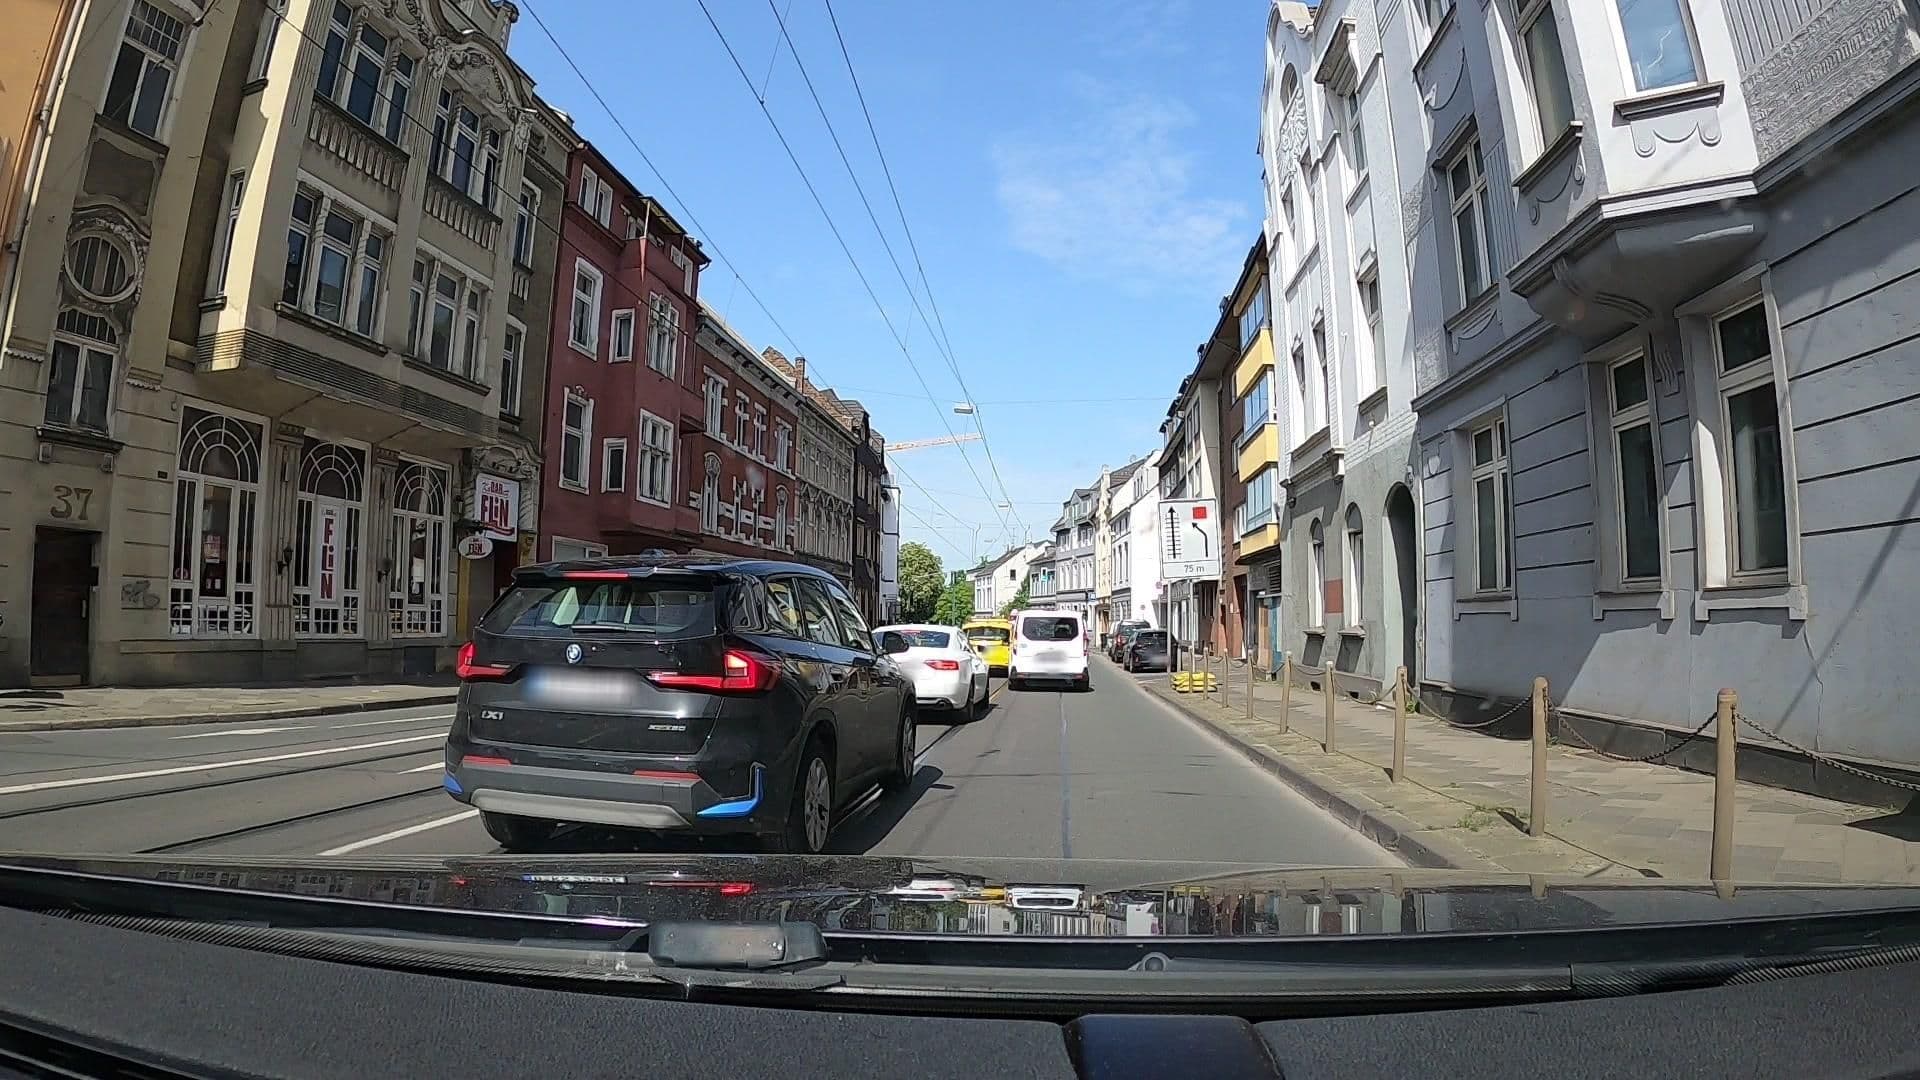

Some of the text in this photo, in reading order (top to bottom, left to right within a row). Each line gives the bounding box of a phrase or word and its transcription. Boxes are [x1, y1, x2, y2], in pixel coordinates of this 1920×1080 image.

[50, 485, 94, 521] 37
[1184, 564, 1205, 574] 75 m
